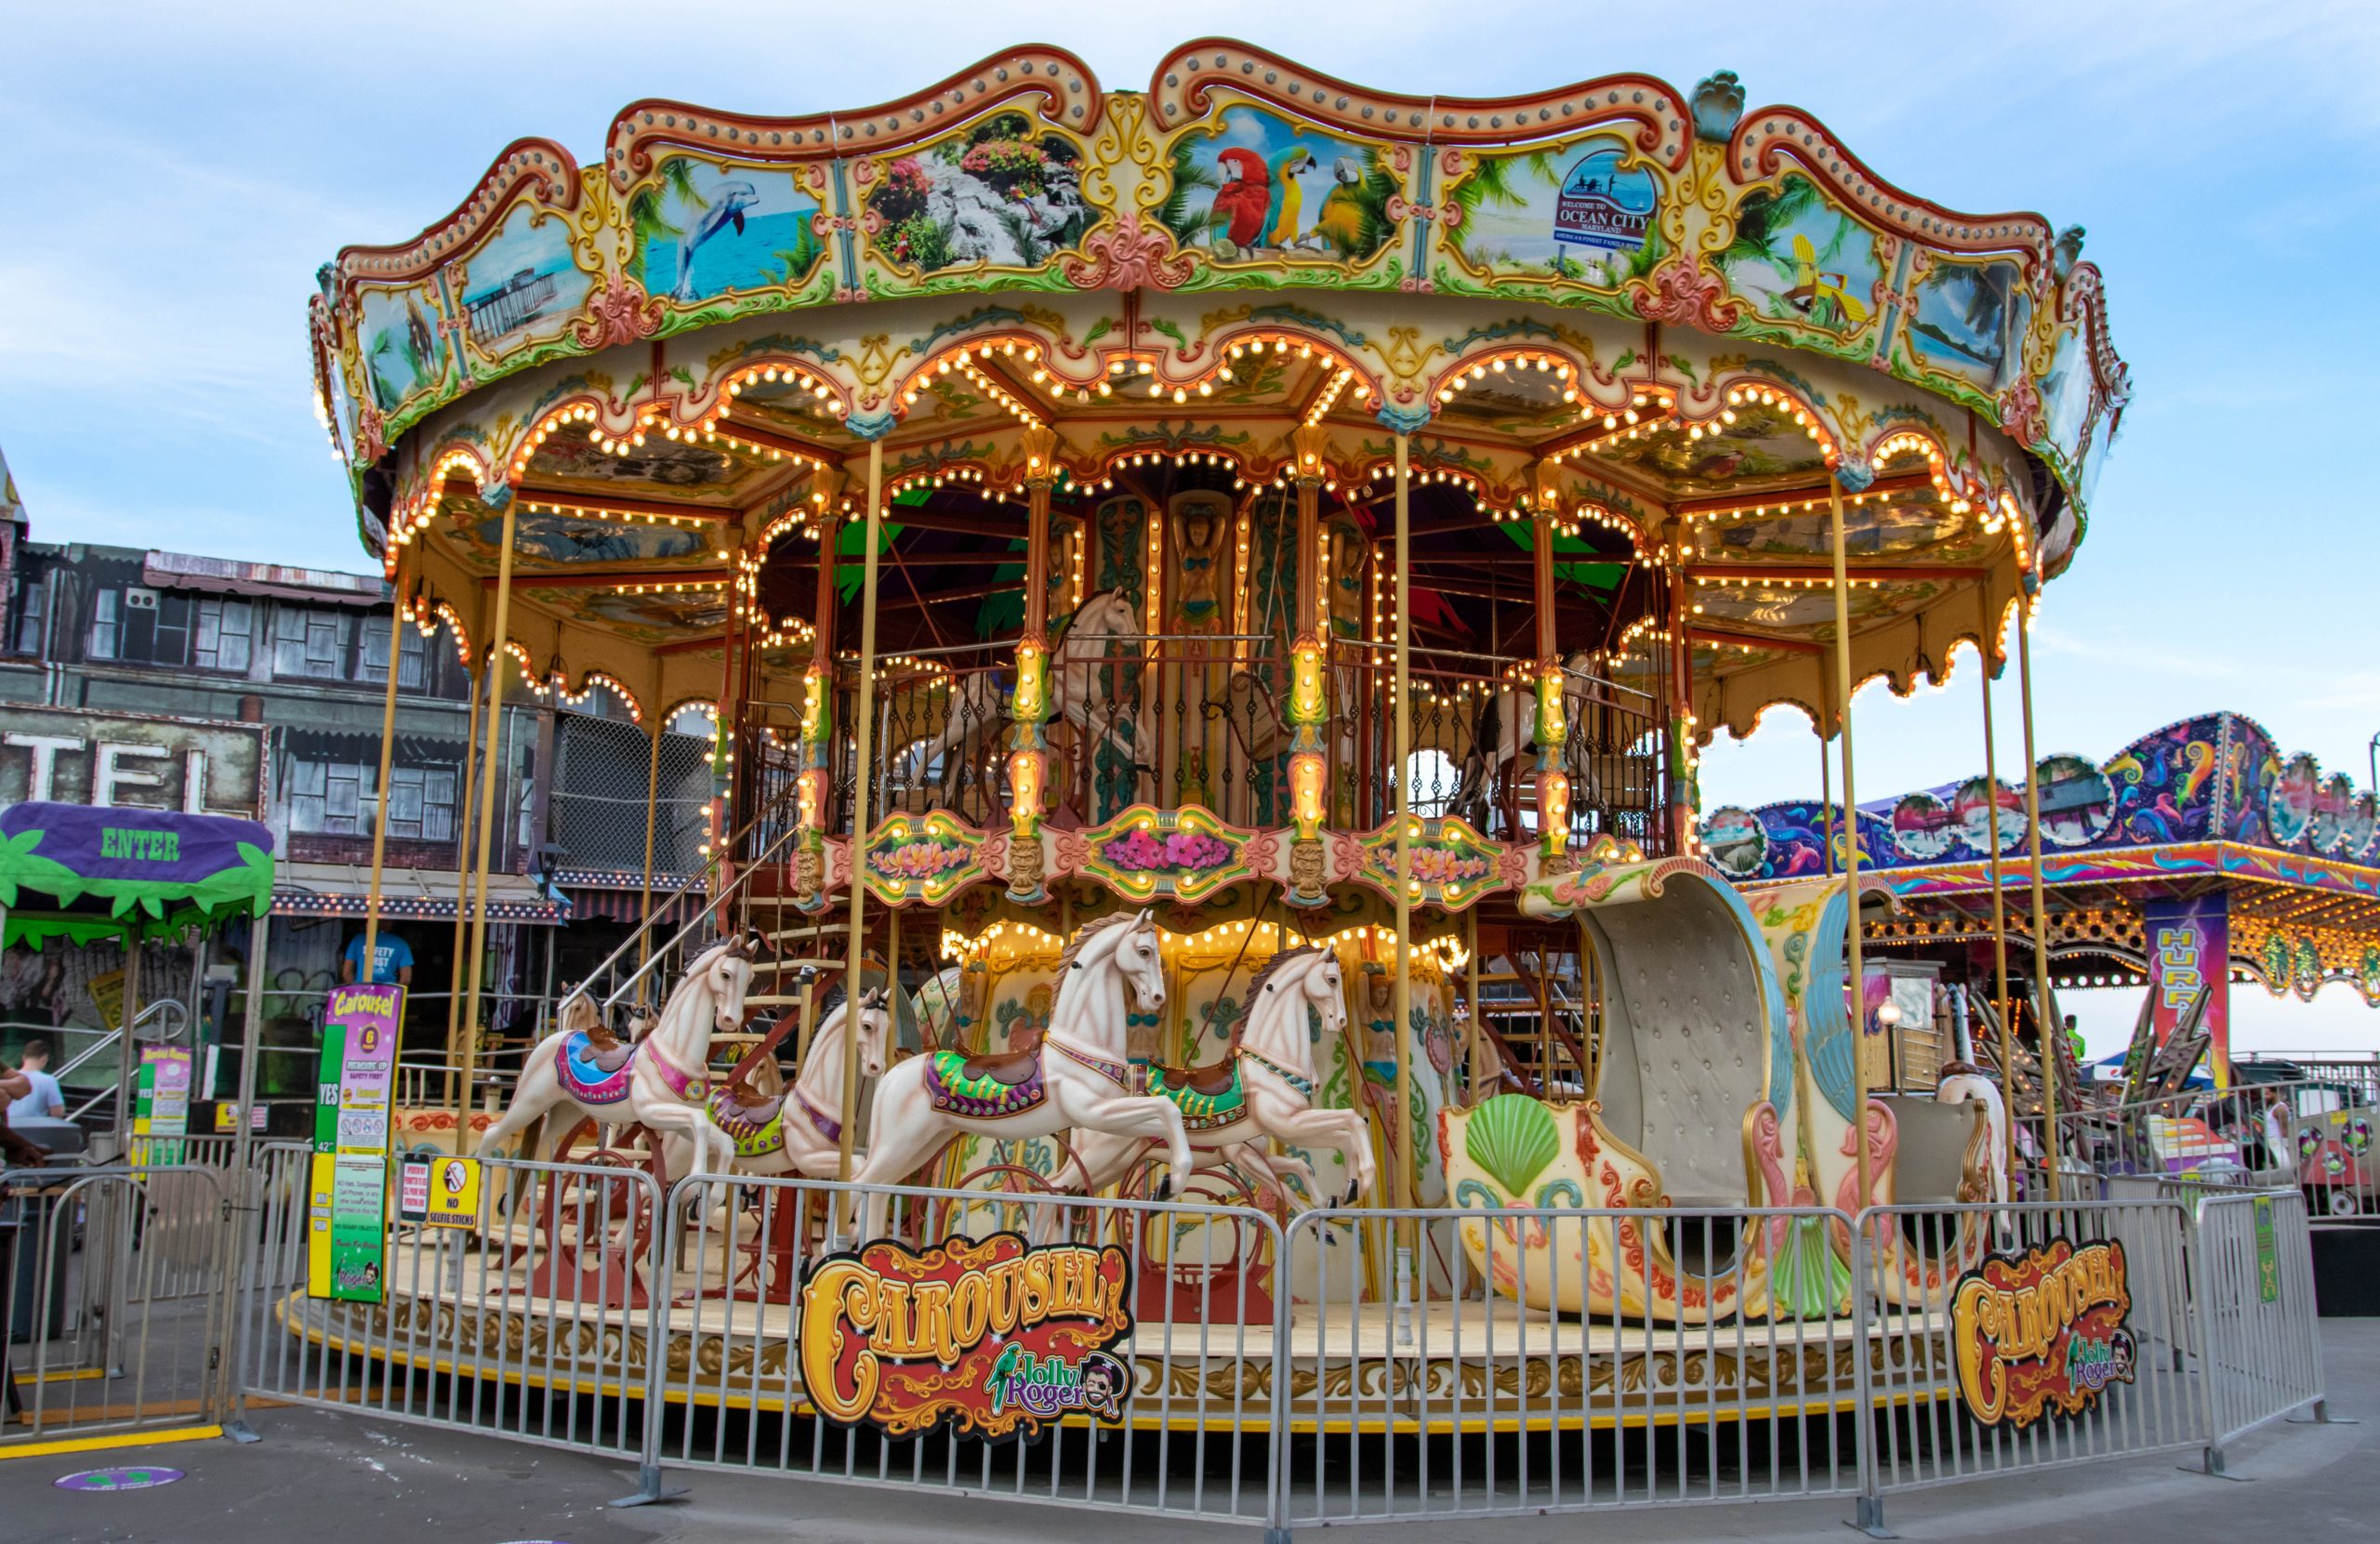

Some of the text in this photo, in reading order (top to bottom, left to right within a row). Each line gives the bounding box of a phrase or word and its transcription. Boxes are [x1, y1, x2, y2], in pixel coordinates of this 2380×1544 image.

[1562, 201, 1594, 209] WELCOME
[1560, 210, 1650, 230] OCEAN CITY
[1581, 224, 1621, 234] MARYLAND
[100, 827, 180, 862] ENTER
[335, 991, 394, 1020] Carousel
[365, 1030, 375, 1044] 6
[320, 1083, 338, 1105] YES
[446, 1198, 458, 1207] NO
[430, 1212, 474, 1225] SELFIE STICKS
[801, 1246, 1107, 1422] CAROUSEL
[1953, 1245, 2120, 1424] CAROUSEL
[2080, 1340, 2110, 1365] Jolly
[1015, 1354, 1079, 1387] Jolly
[2075, 1360, 2114, 1388] Roger
[1007, 1376, 1085, 1414] Roger
